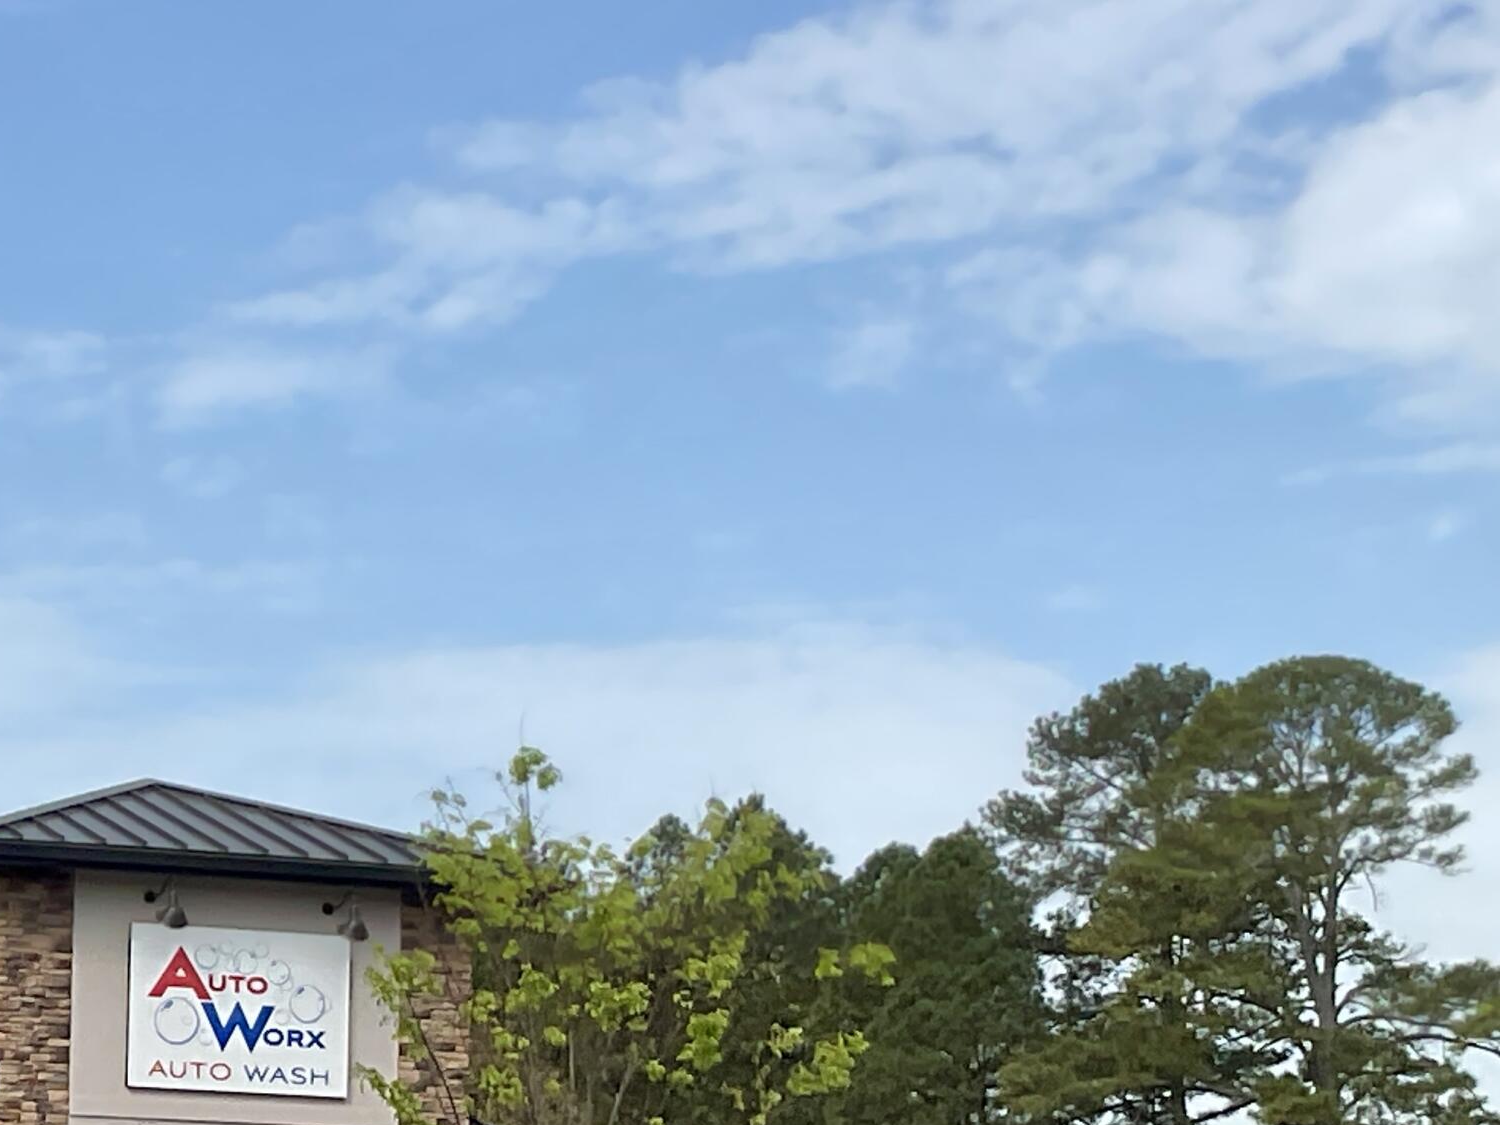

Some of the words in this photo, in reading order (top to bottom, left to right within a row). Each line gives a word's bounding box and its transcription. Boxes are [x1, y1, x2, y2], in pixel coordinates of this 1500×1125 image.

[148, 946, 268, 1001] AUTO
[201, 1001, 327, 1053] WORX
[148, 1060, 231, 1081] AUTO
[244, 1065, 330, 1087] WASH
